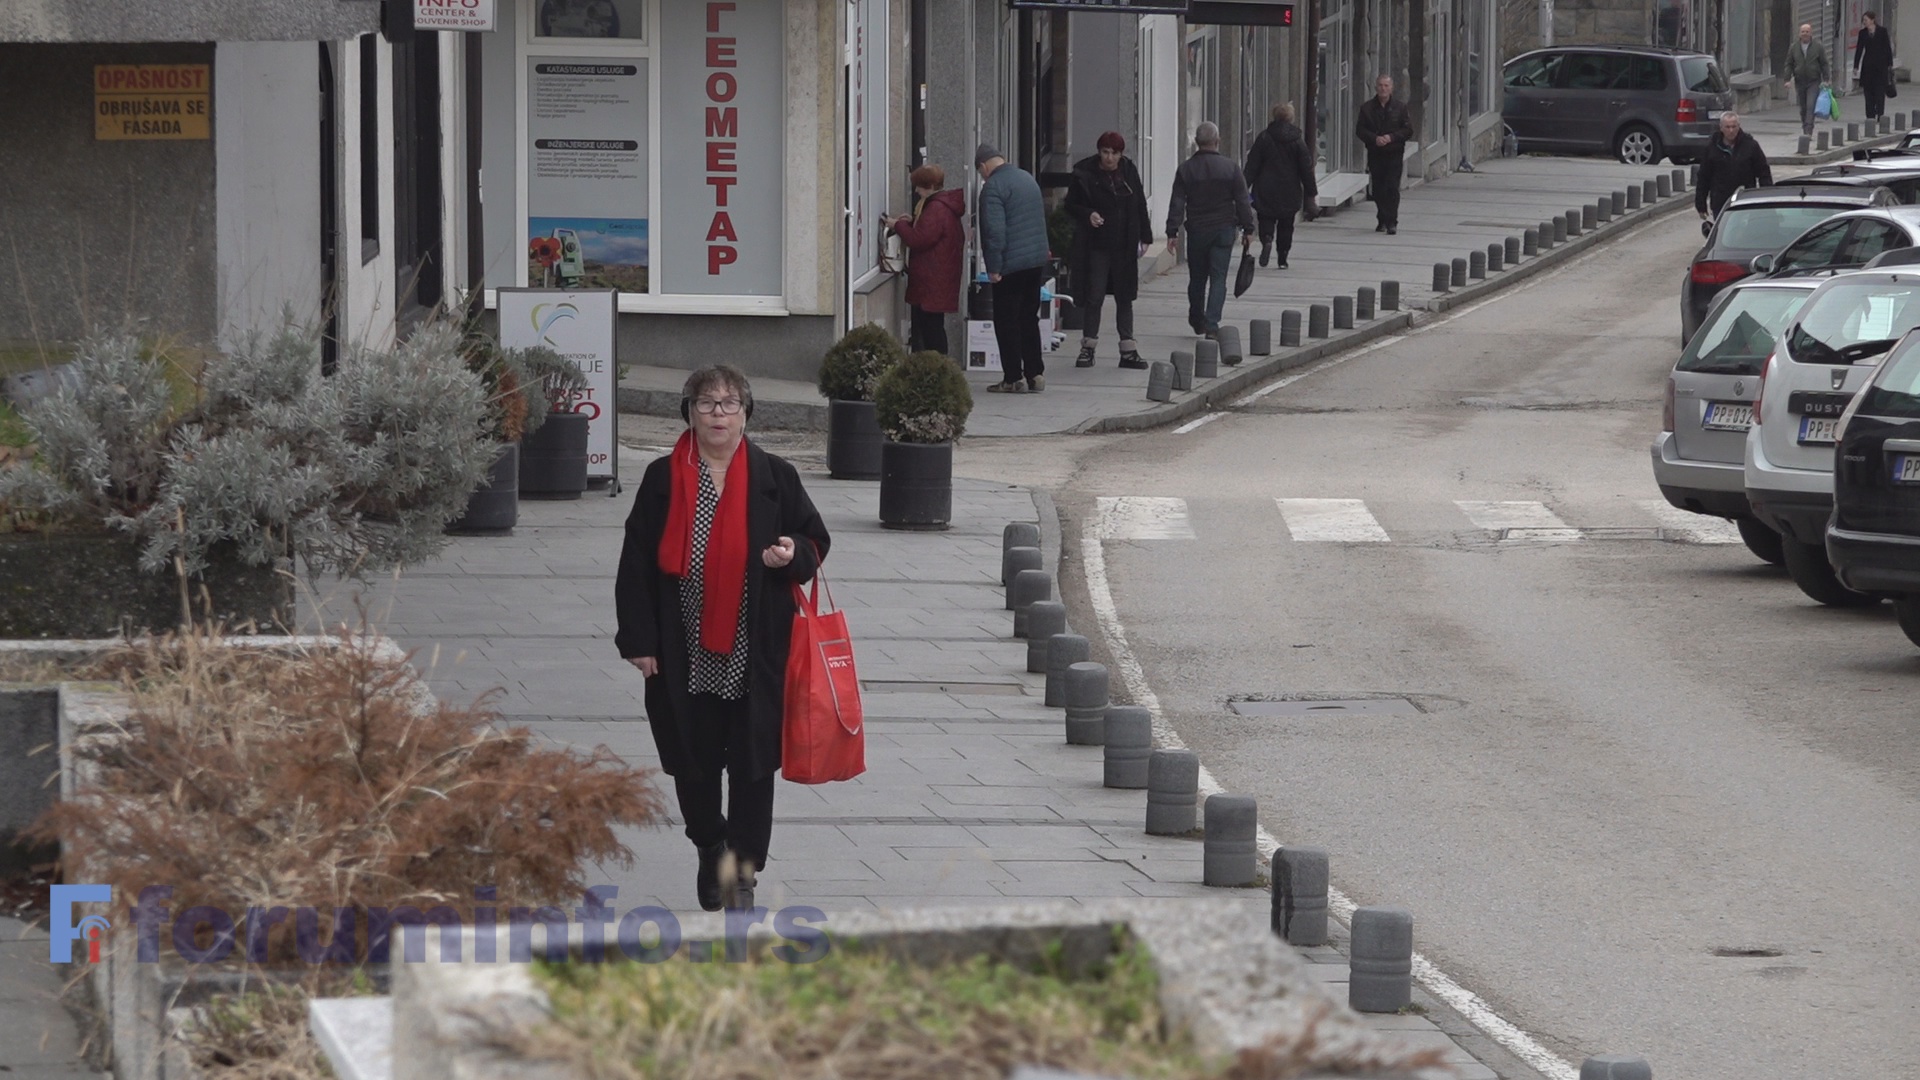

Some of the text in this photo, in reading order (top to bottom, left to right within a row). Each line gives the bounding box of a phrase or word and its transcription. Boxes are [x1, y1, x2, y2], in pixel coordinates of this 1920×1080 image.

[421, 8, 465, 17] CENTER
[597, 66, 625, 75] USLUGE
[98, 69, 204, 89] OPASNOST
[100, 97, 205, 116] OBRUŠAVA SE
[123, 120, 182, 135] FASADA
[705, 2, 738, 275] ГЕОМЕТАР
[597, 141, 625, 149] USLUGE
[1805, 403, 1843, 413] DUST
